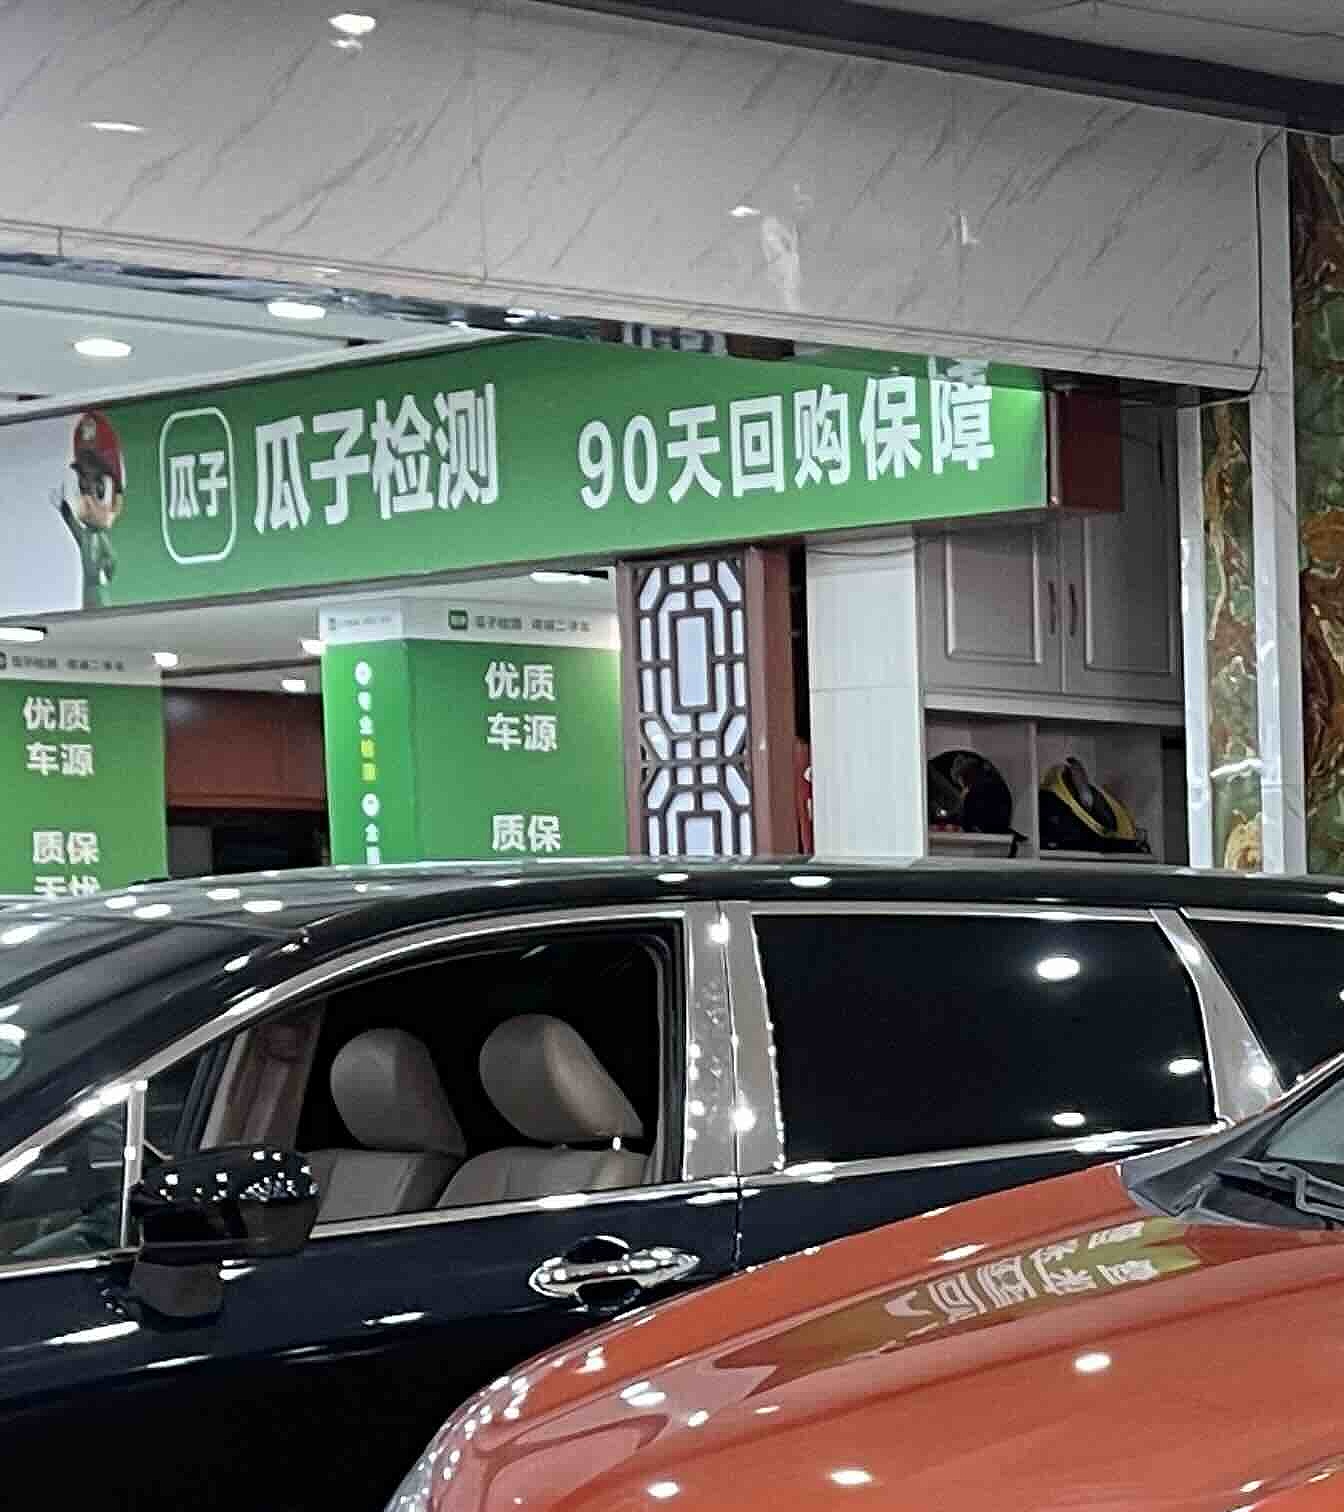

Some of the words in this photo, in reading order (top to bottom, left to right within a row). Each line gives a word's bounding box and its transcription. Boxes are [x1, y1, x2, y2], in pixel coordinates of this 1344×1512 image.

[253, 382, 499, 535] 瓜子检测
[577, 374, 996, 510] 90天回购保障
[168, 450, 228, 520] 瓜子
[485, 661, 556, 702] 优质
[23, 695, 92, 733] 优质
[487, 712, 559, 752] 车源
[25, 742, 95, 777] 车源
[31, 831, 100, 865] 质保
[491, 814, 562, 852] 质保
